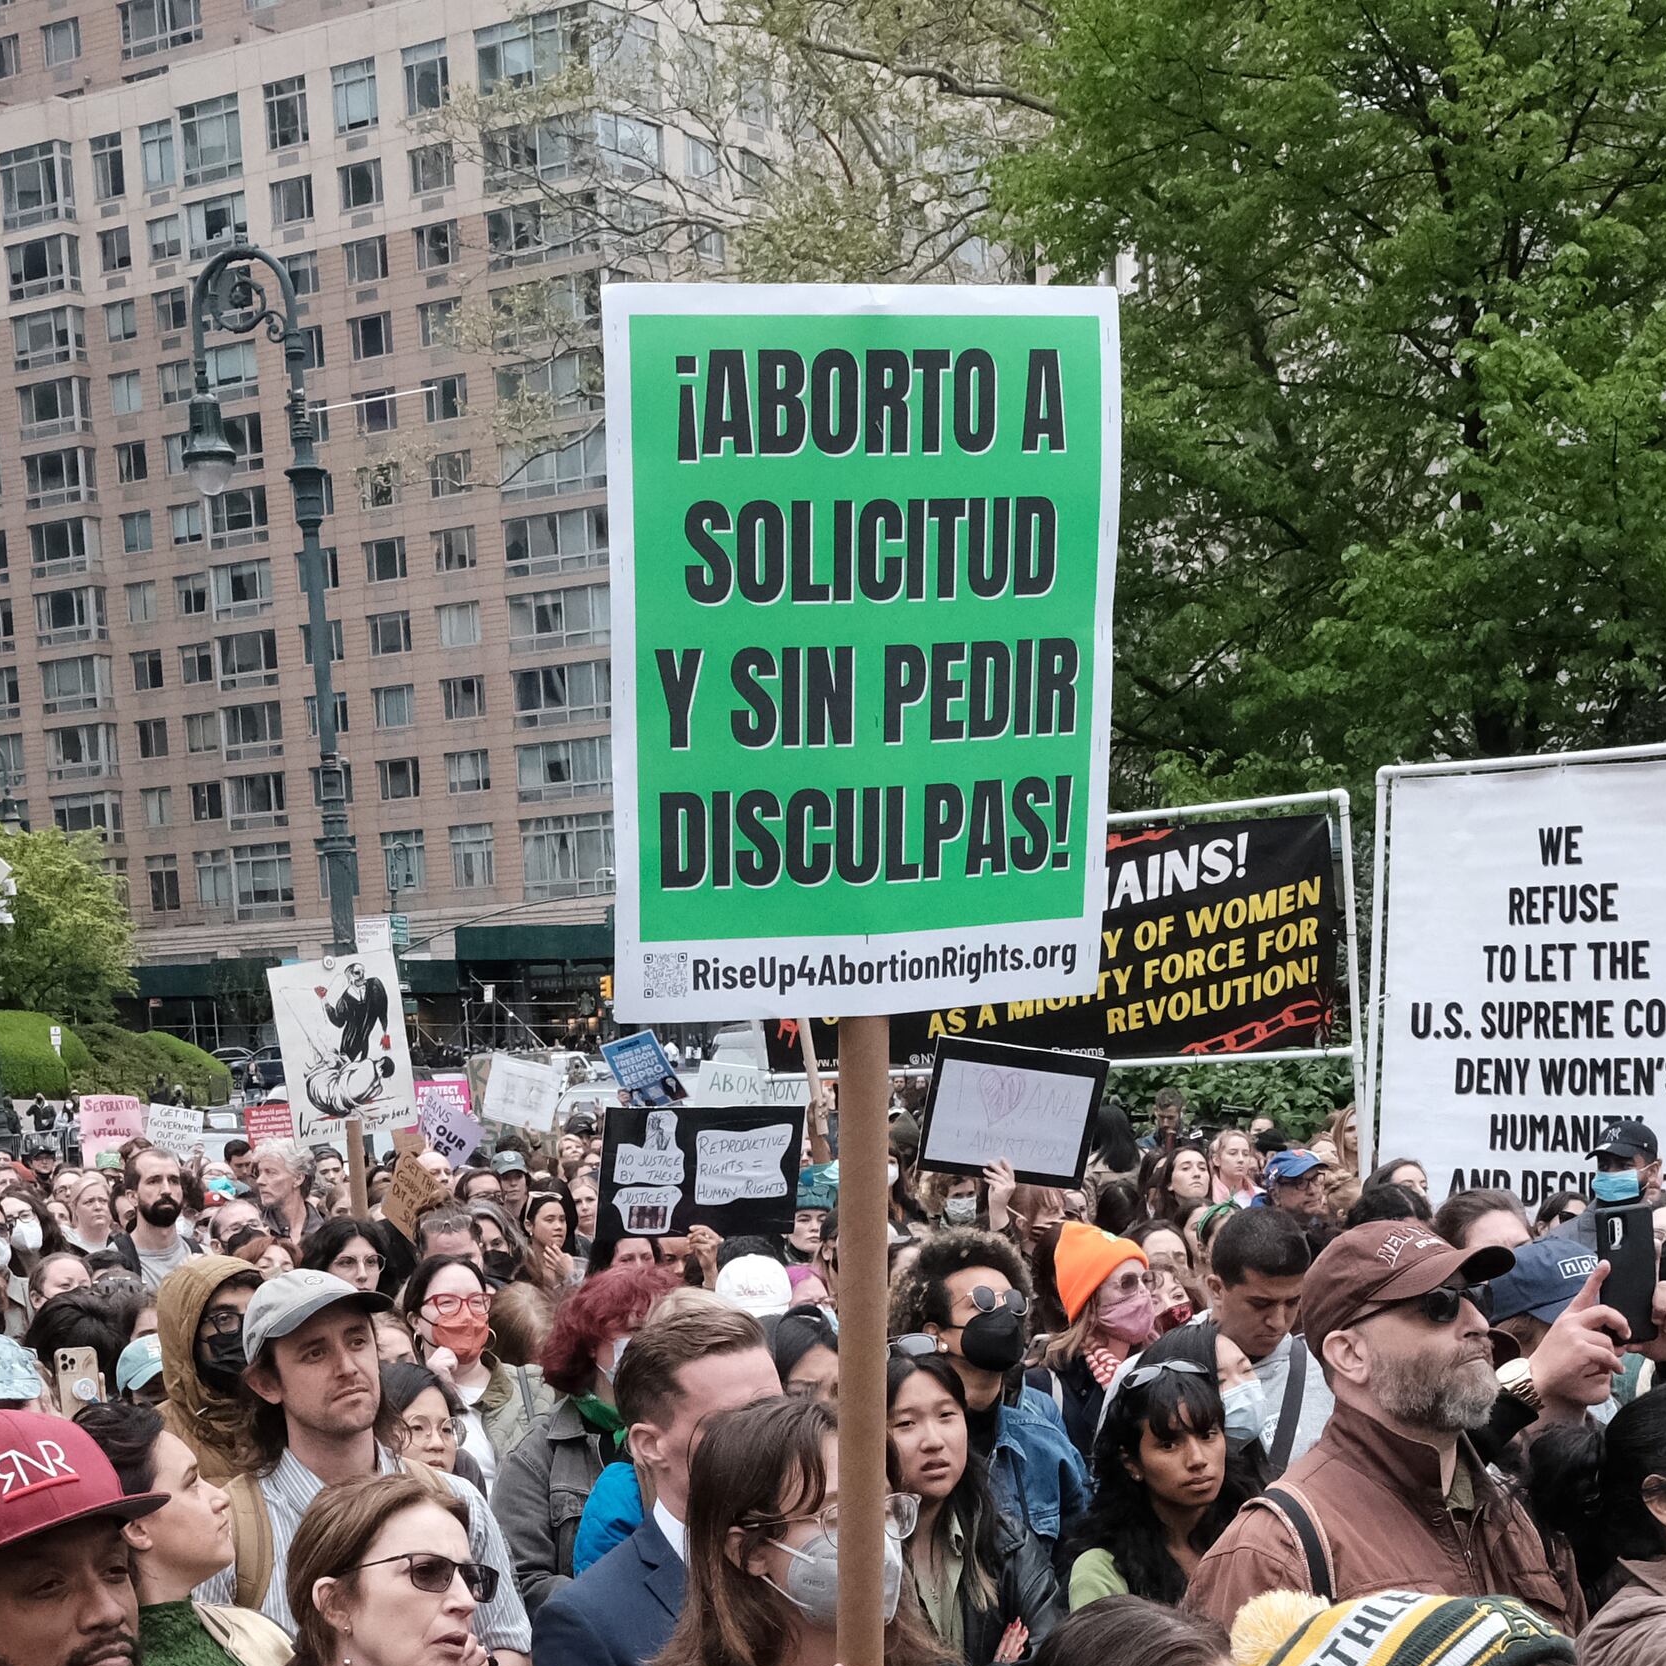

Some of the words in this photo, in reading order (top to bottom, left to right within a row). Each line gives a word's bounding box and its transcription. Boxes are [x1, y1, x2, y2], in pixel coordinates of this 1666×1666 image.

[676, 348, 1000, 463] ¡ABORTO
[1023, 348, 1066, 453] A
[685, 495, 1058, 606] SOLICITUD
[656, 648, 704, 750] Y
[730, 646, 858, 749] SIN
[883, 637, 1080, 745] PEDIR
[659, 775, 1073, 891] DISCULPAS!
[1538, 825, 1583, 867] WE
[1104, 832, 1248, 911] AINS!
[1133, 916, 1175, 953] OF
[1186, 876, 1321, 922] WOMEN
[1508, 882, 1619, 926] REFUSE
[1144, 937, 1247, 990] FORCE
[1258, 916, 1321, 963] FOR
[1483, 944, 1517, 983] TO
[1525, 942, 1577, 982] LET
[1587, 940, 1651, 981] THE
[692, 941, 1077, 995] RiseUp4AbortionRights.org
[1106, 956, 1320, 1035] REVOLUTION!
[1411, 1002, 1472, 1039] U.S.
[1480, 999, 1614, 1039] SUPREME
[615, 1048, 656, 1069] FREEDOM
[618, 1056, 658, 1075] WITHOUT
[623, 1064, 664, 1087] REPRO
[1454, 1058, 1531, 1096] DENY
[84, 1098, 139, 1113] SEPERATION
[160, 1107, 180, 1119] GET
[182, 1109, 197, 1122] THE
[93, 1126, 132, 1140] UTERUS
[149, 1118, 202, 1135] GOVERNMENT
[156, 1130, 175, 1142] OUT
[176, 1131, 188, 1142] OF
[299, 1112, 318, 1138] We
[321, 1119, 341, 1135] will
[378, 1113, 389, 1125] go
[391, 1106, 410, 1119] back
[435, 1125, 467, 1152] OUR
[697, 1134, 788, 1157] REPRODUCTIVE
[402, 1156, 420, 1174] GET
[618, 1154, 633, 1167] NO
[639, 1153, 682, 1168] JUSTICE
[699, 1159, 744, 1177] RIGHTS
[620, 1170, 634, 1182] BY
[646, 1169, 682, 1182] THESE
[696, 1184, 738, 1200] HUMAN
[744, 1178, 786, 1195] RIGHTS
